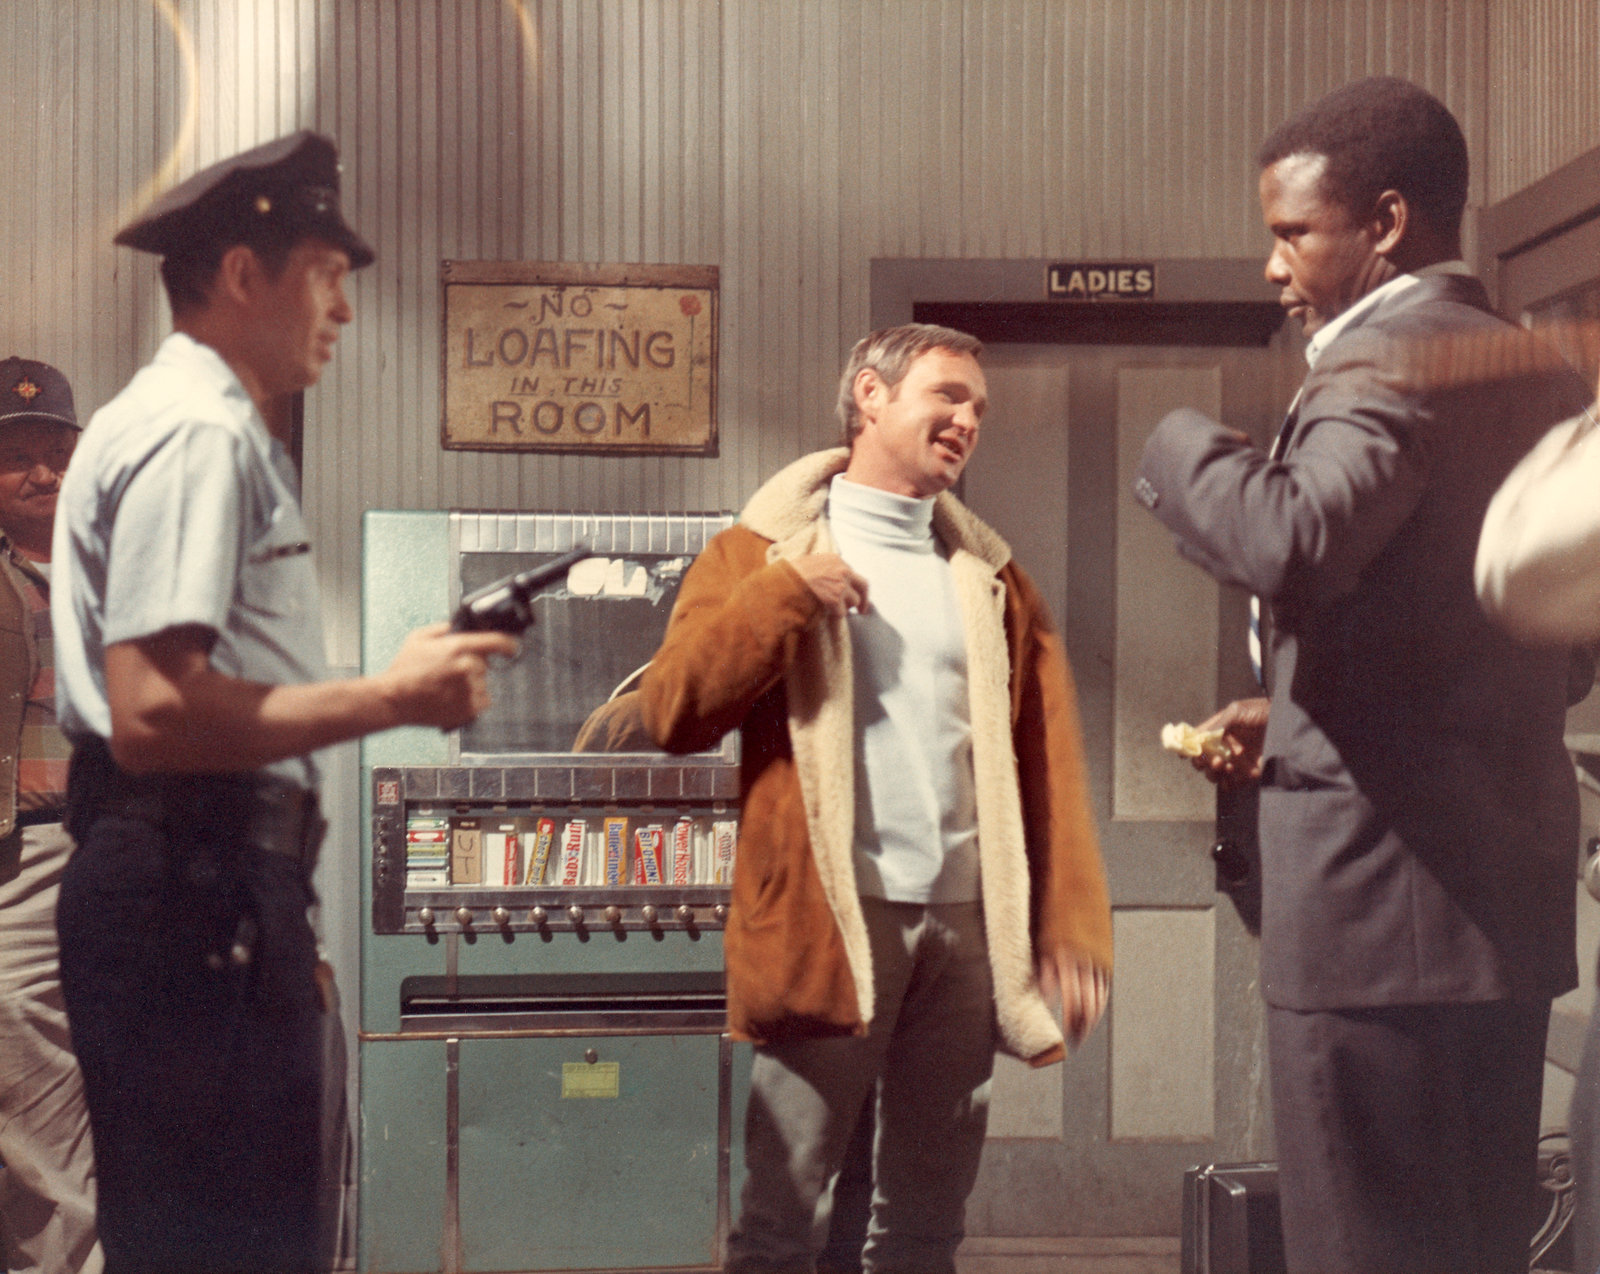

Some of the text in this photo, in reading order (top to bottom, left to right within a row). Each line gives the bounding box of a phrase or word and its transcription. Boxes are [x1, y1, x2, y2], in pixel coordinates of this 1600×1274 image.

[1051, 270, 1153, 292] LADIES
[529, 293, 593, 326] NO
[463, 327, 676, 370] LOAFING
[510, 376, 624, 394] IN THIS
[490, 400, 651, 437] ROOM
[563, 823, 582, 886] Baby Ruth
[640, 832, 659, 883] BIT-O-HONE
[674, 853, 690, 887] House
